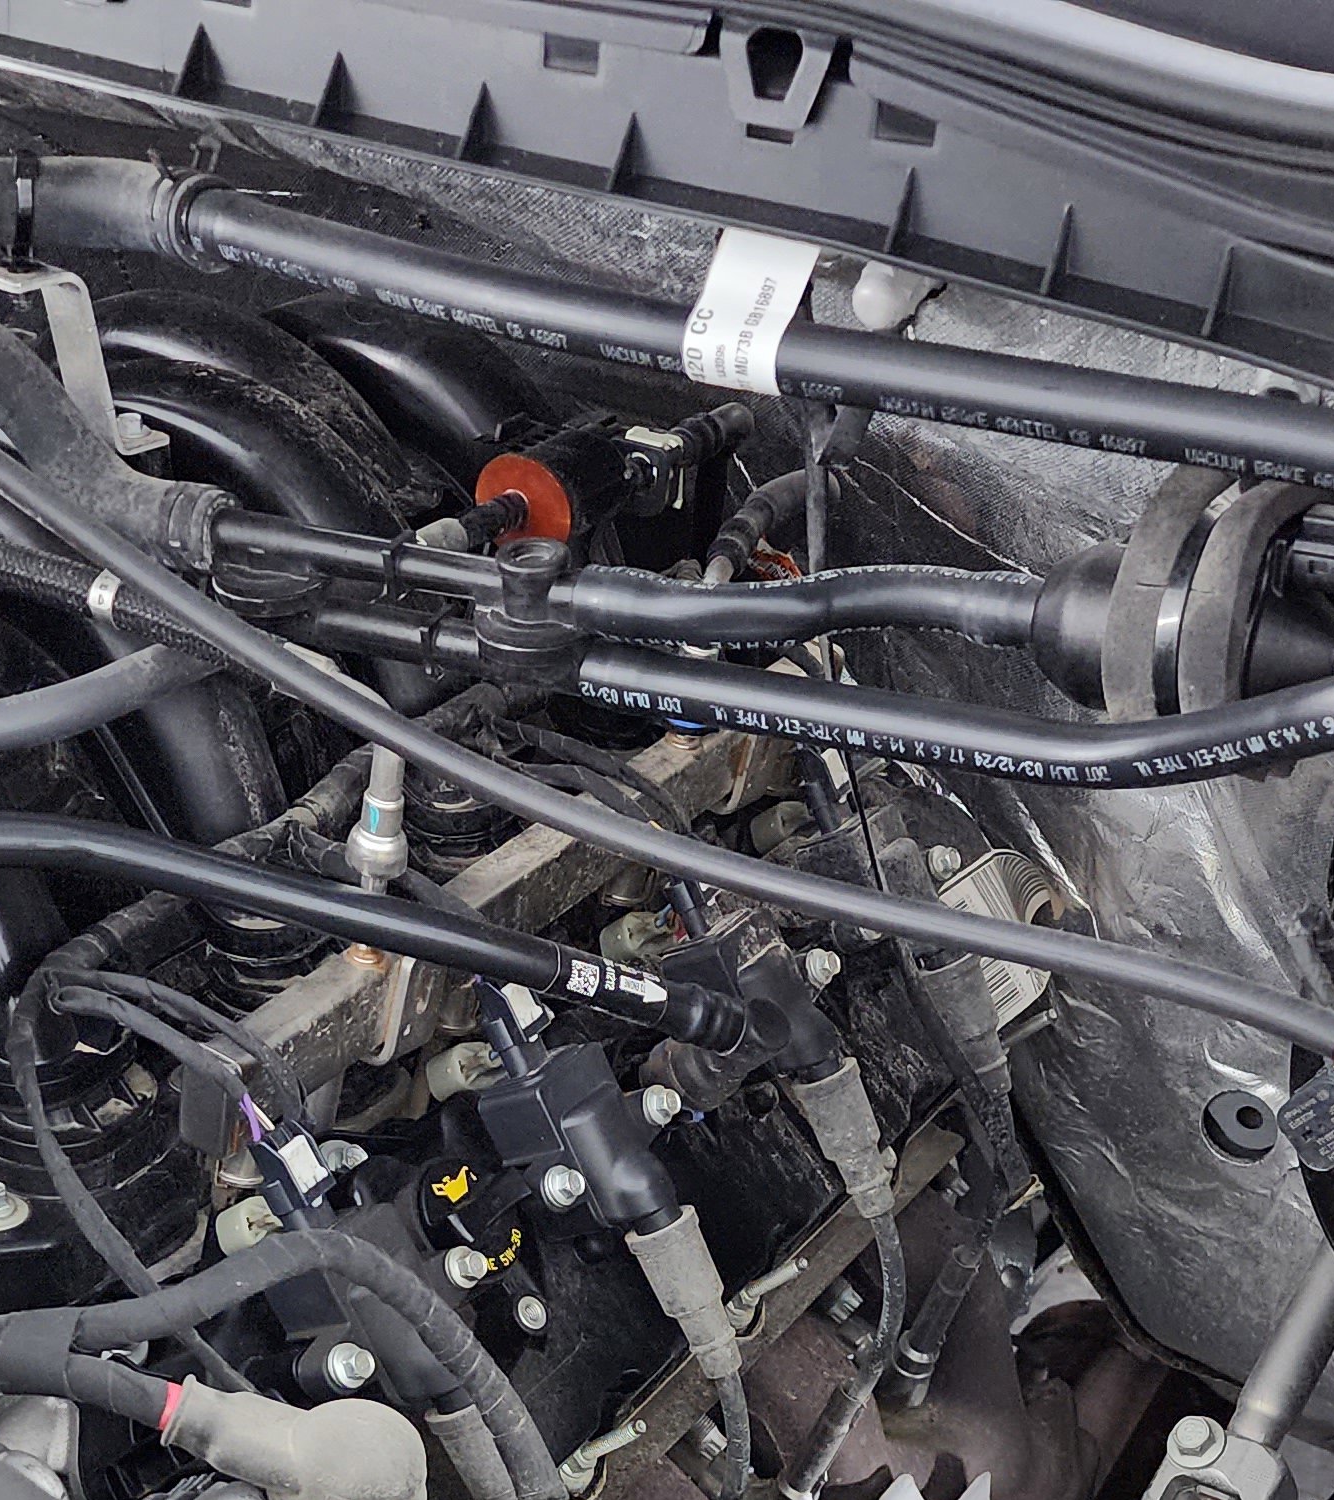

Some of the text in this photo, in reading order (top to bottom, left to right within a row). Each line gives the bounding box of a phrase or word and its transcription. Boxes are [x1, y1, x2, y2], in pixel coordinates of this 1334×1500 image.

[690, 307, 714, 336] CC
[656, 695, 682, 714] DOT
[734, 707, 770, 730] TYPE
[930, 743, 967, 764] 17.6
[973, 751, 1045, 778] 03/12/24
[498, 1228, 522, 1267] 5W-30
